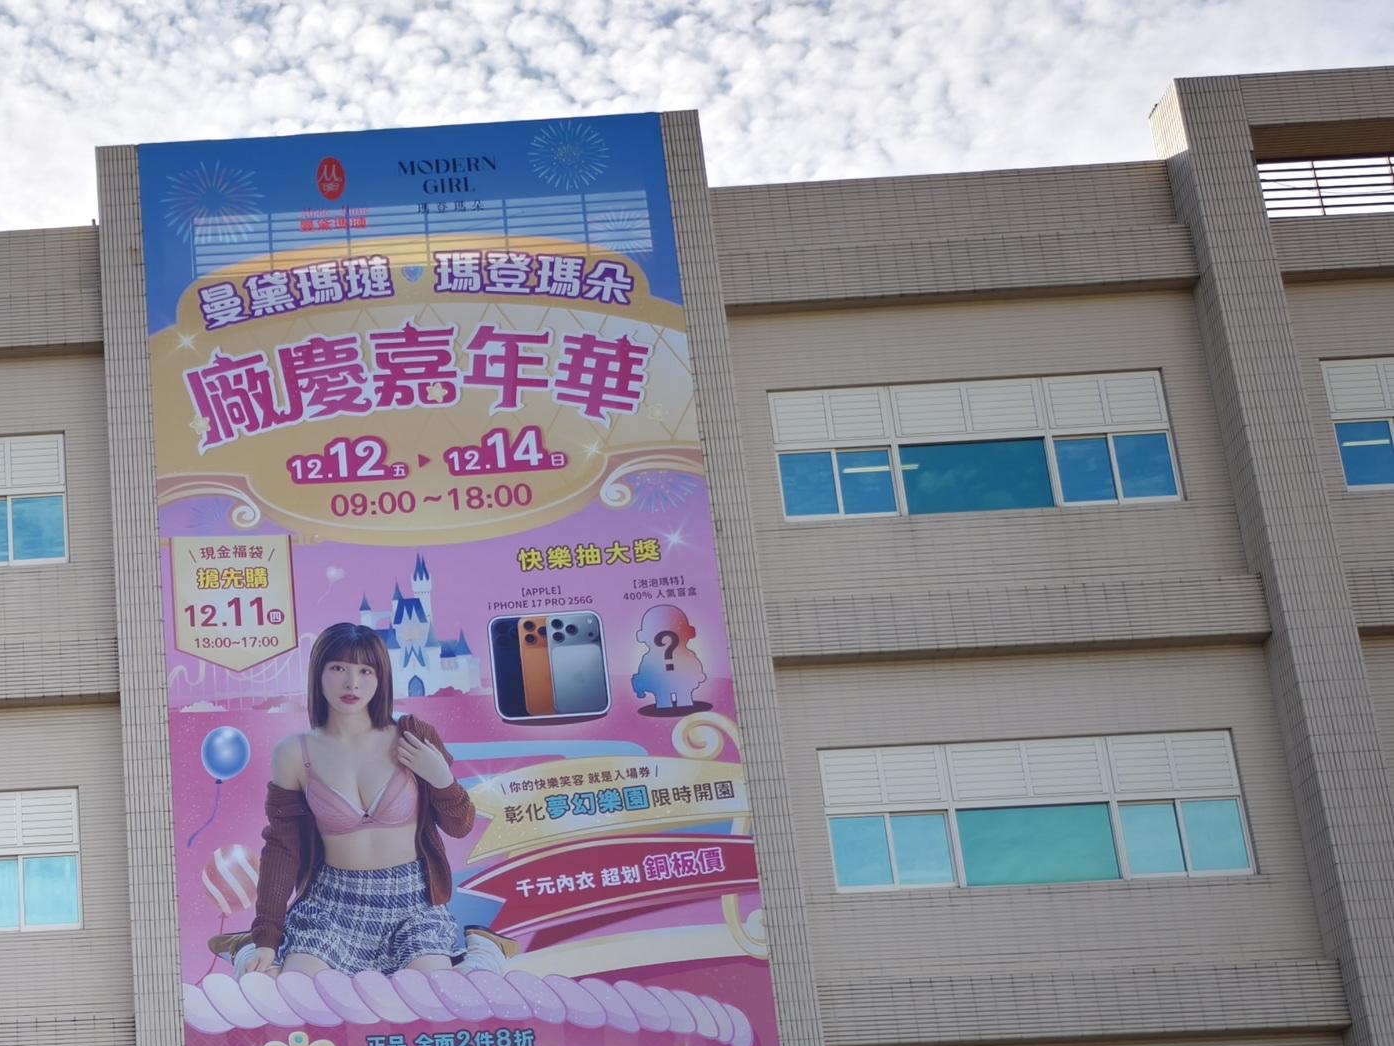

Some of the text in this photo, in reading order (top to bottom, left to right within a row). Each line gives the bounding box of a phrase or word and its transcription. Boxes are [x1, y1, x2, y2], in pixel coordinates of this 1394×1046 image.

[398, 155, 497, 176] MODERN
[423, 177, 476, 195] GIRL
[199, 251, 634, 330] 曼黛瑪璉 瑪登瑪朵
[183, 317, 653, 453] 廠慶嘉年華
[201, 545, 264, 560] 現金福袋
[517, 538, 661, 573] 快樂抽大獎
[196, 567, 269, 590] 搶先購
[531, 598, 543, 609] 17
[545, 597, 566, 607] PRO
[568, 595, 593, 605] 256G
[623, 591, 653, 601] 400%
[194, 636, 279, 649] 13:00~17:00
[504, 780, 735, 825] 彰化夢幻樂園限時開園
